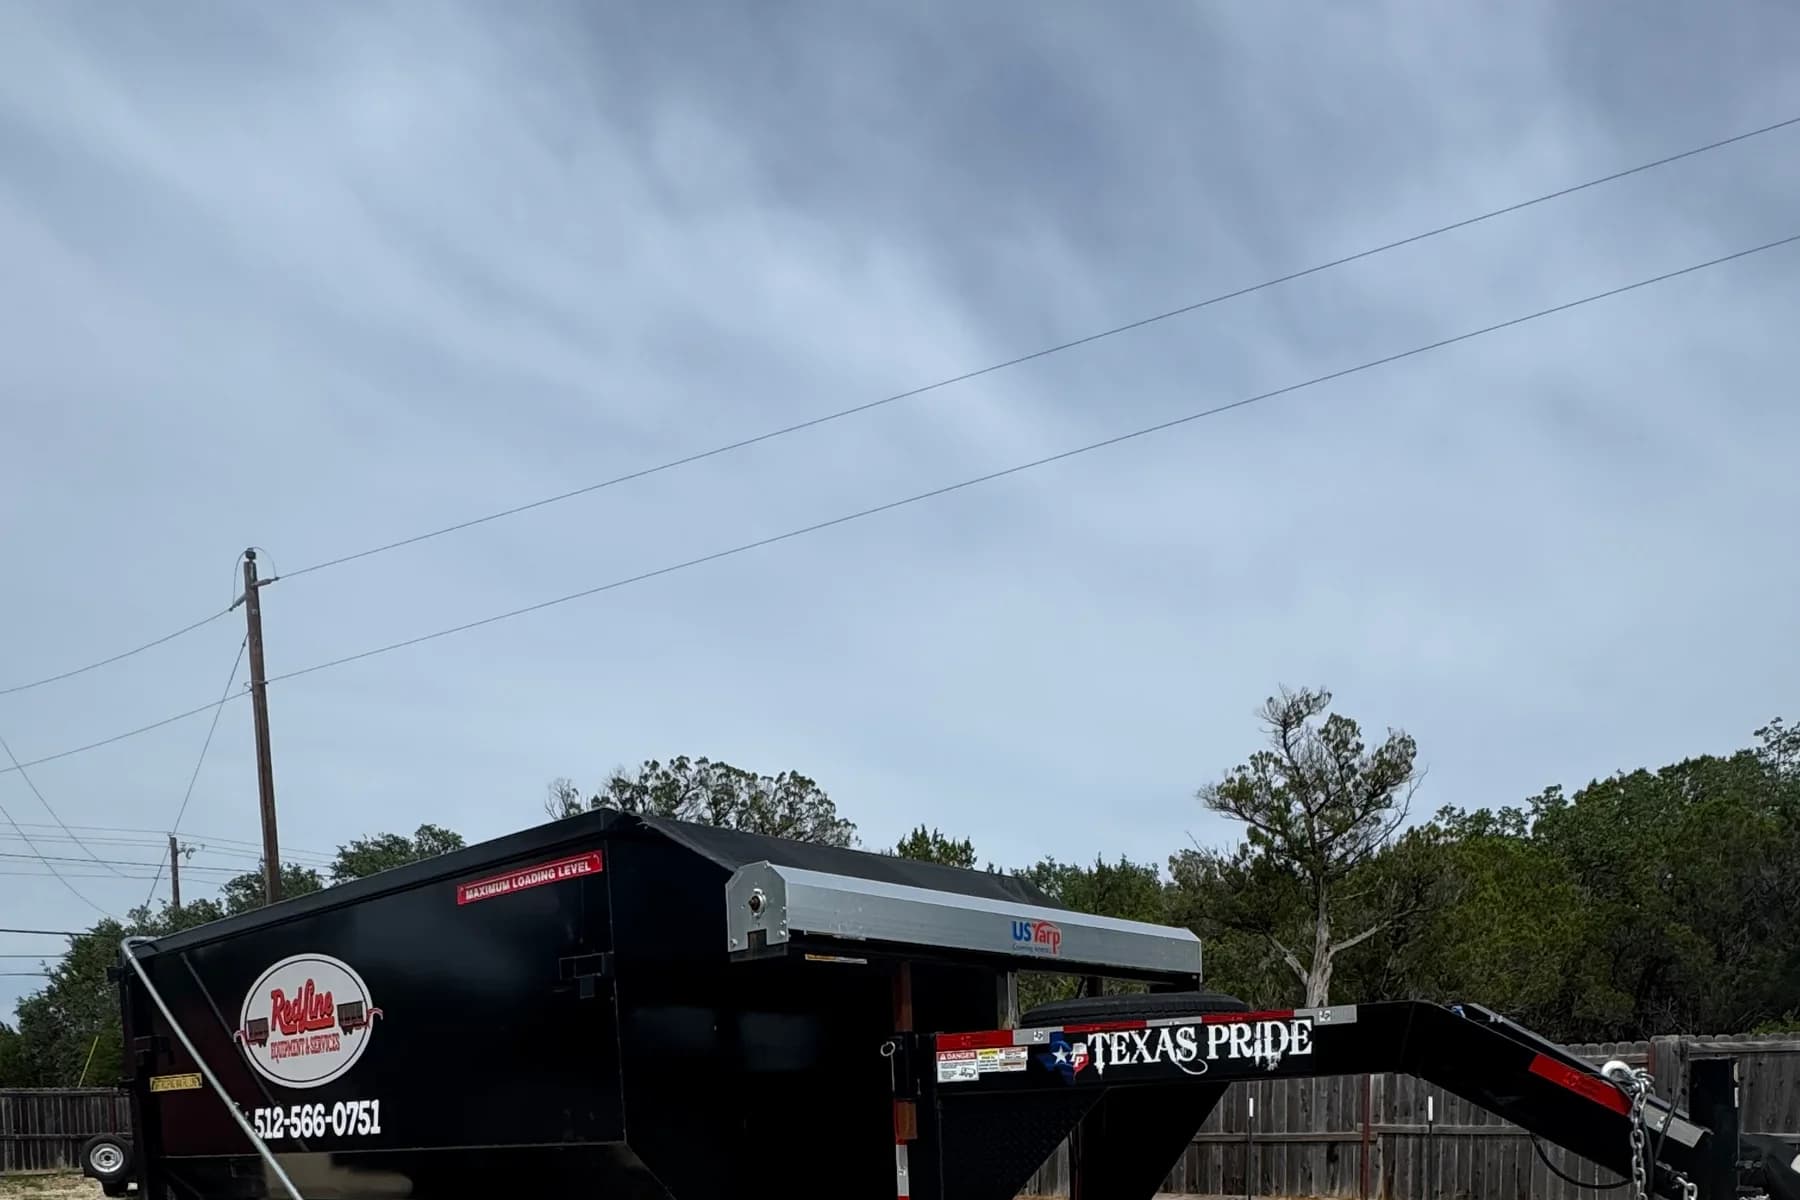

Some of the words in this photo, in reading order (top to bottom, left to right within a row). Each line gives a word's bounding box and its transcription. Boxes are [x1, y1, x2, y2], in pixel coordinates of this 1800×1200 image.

[465, 881, 510, 900] MAXIMUM
[512, 869, 555, 889] LOADING
[558, 861, 592, 877] LEVEL
[270, 1038, 305, 1064] EQUIPMENT
[310, 1033, 341, 1054] SERVICES
[946, 1051, 976, 1061] DANGER
[1088, 1026, 1208, 1076] TEXAS
[1206, 1019, 1313, 1071] PRIDE
[254, 1099, 382, 1140] 512-566-0751
